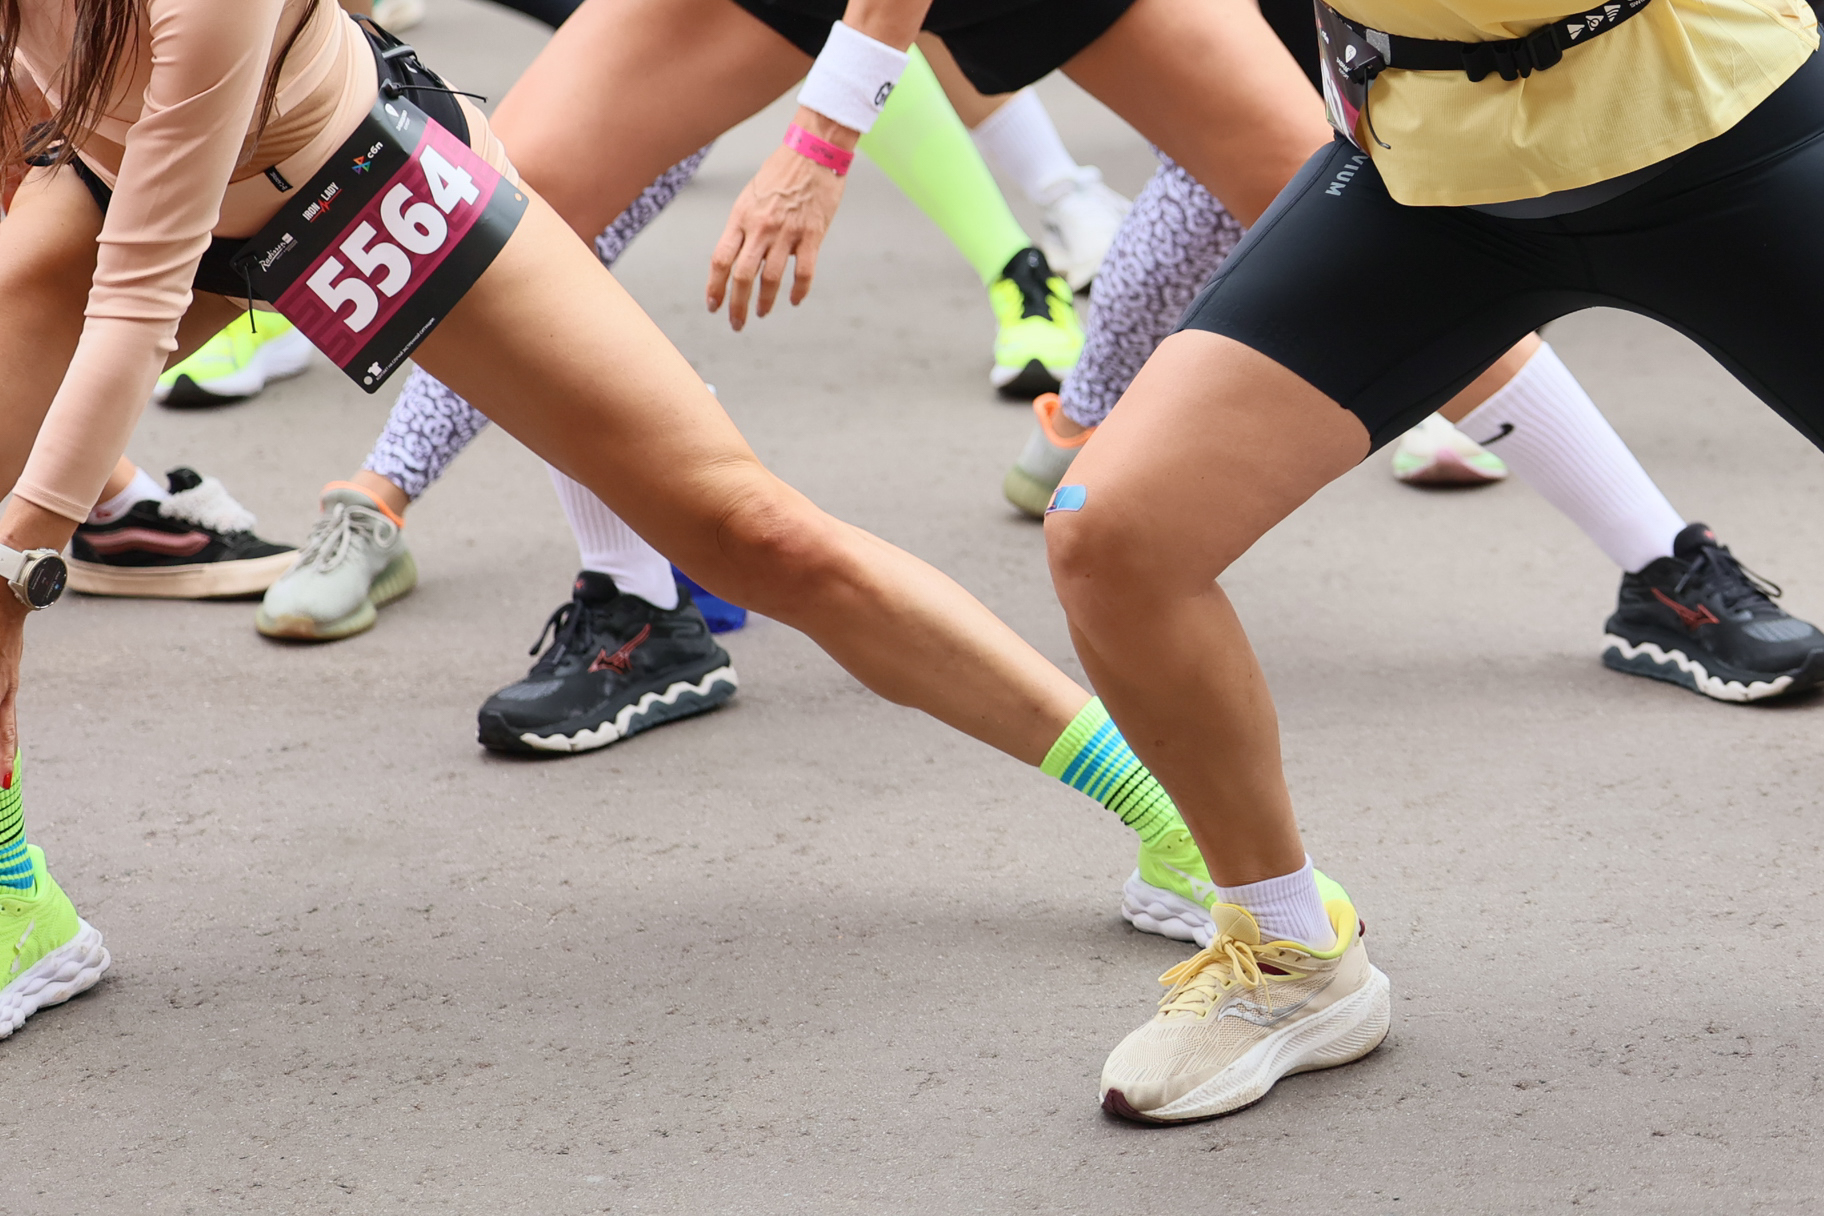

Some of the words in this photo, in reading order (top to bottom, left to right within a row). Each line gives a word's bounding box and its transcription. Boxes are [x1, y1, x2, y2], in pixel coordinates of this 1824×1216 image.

[367, 141, 384, 159] сбп
[302, 202, 321, 222] IRON
[320, 182, 340, 202] LADY
[305, 144, 480, 333] 5564
